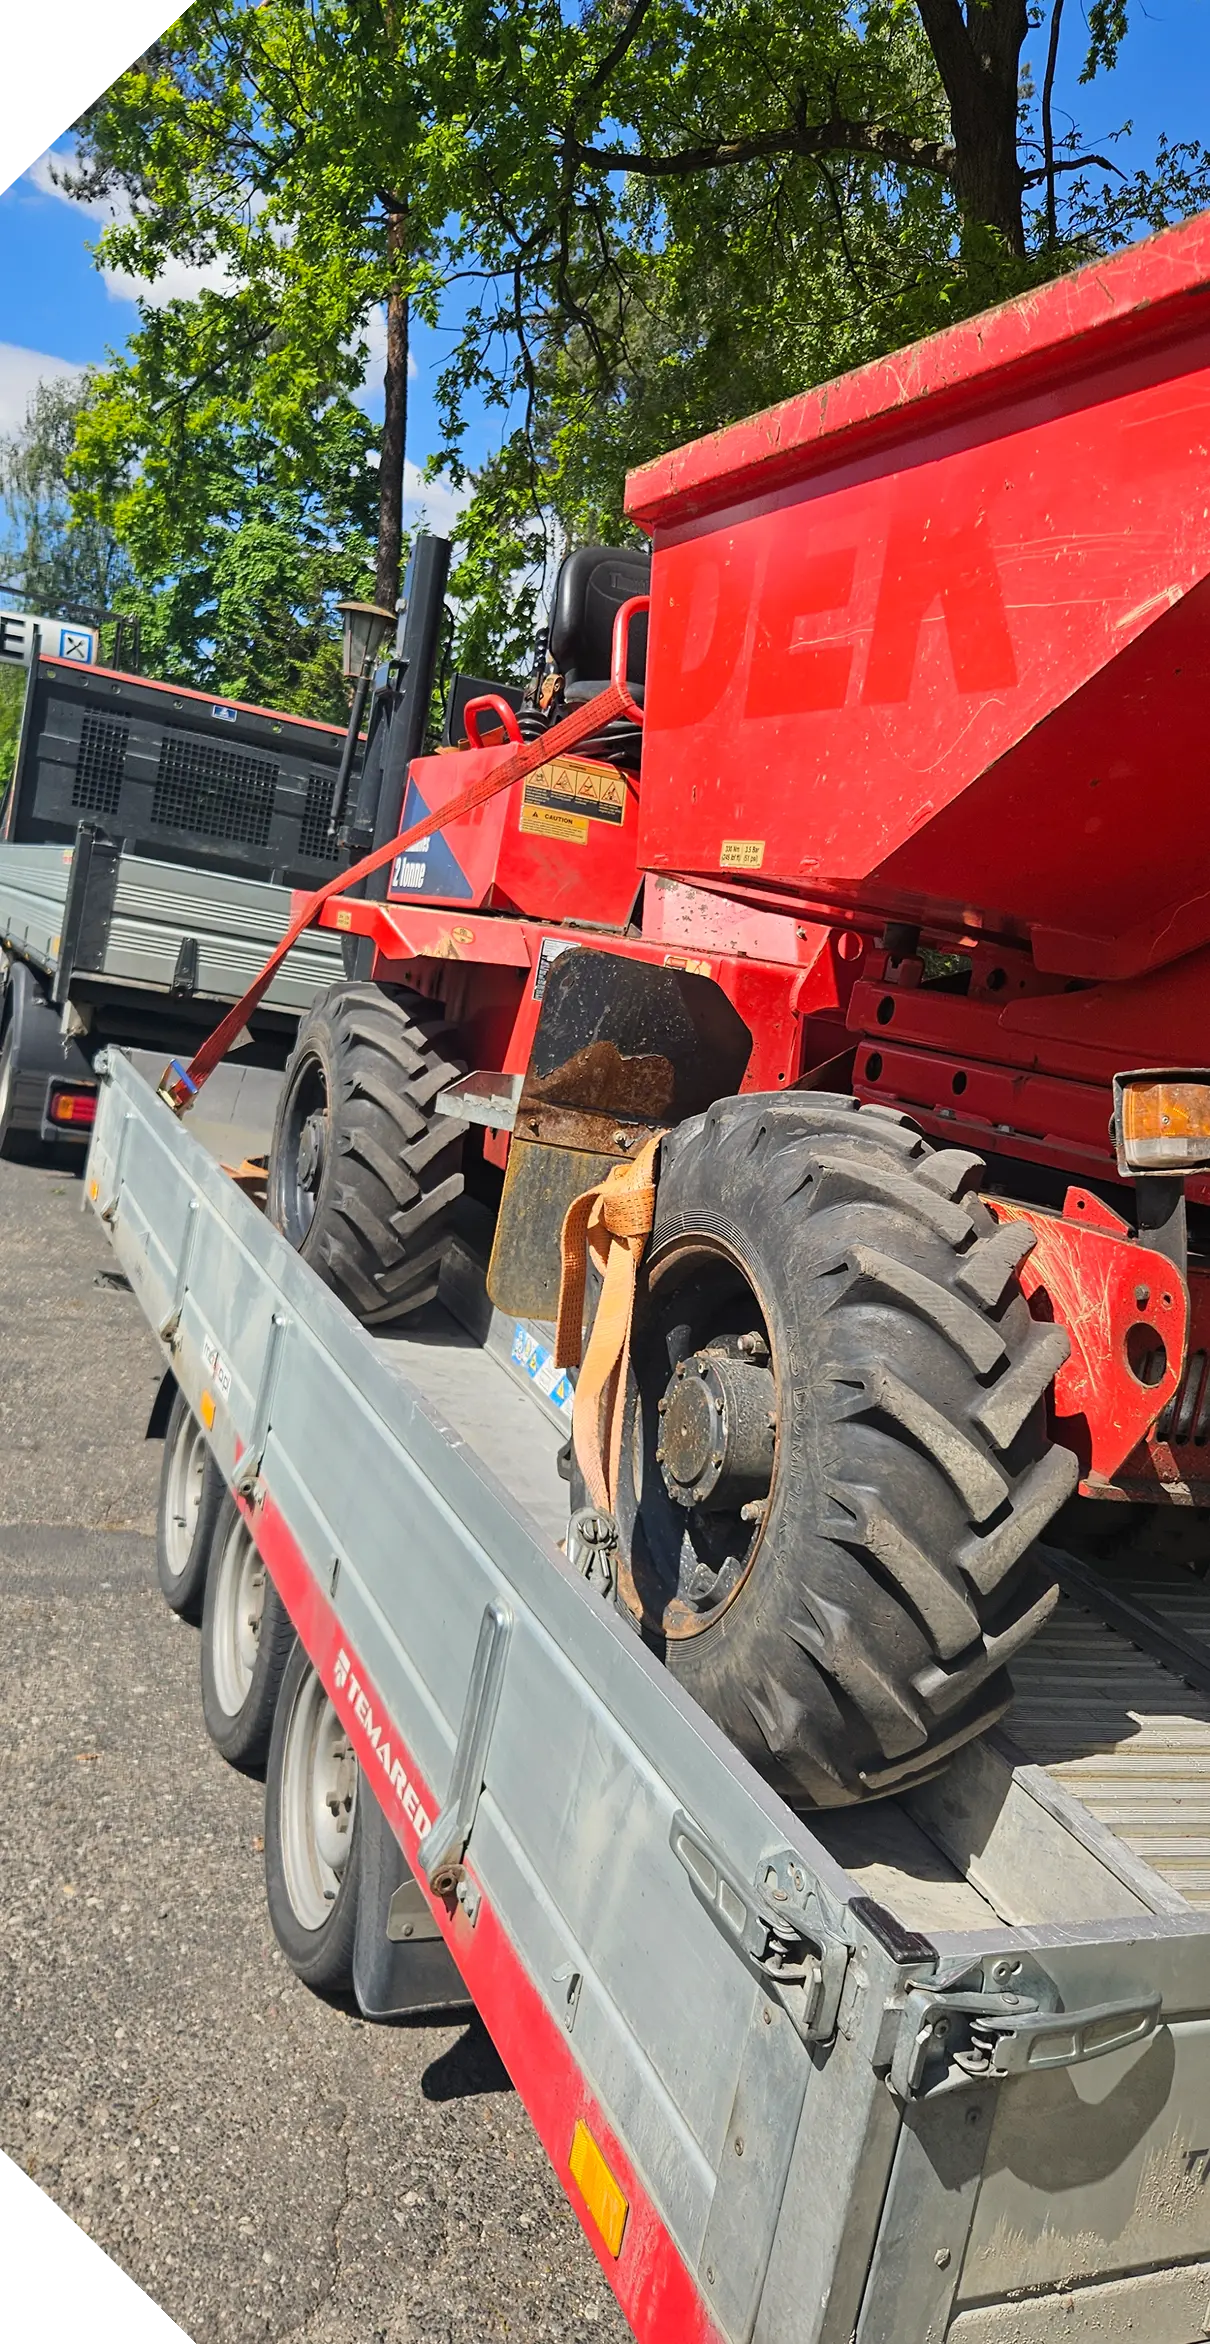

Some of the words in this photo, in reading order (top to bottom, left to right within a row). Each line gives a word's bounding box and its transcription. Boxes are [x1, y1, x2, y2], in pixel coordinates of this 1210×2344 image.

[544, 813, 573, 825] CAUTION
[392, 857, 402, 887] 2
[348, 1672, 433, 1841] TEMARED
